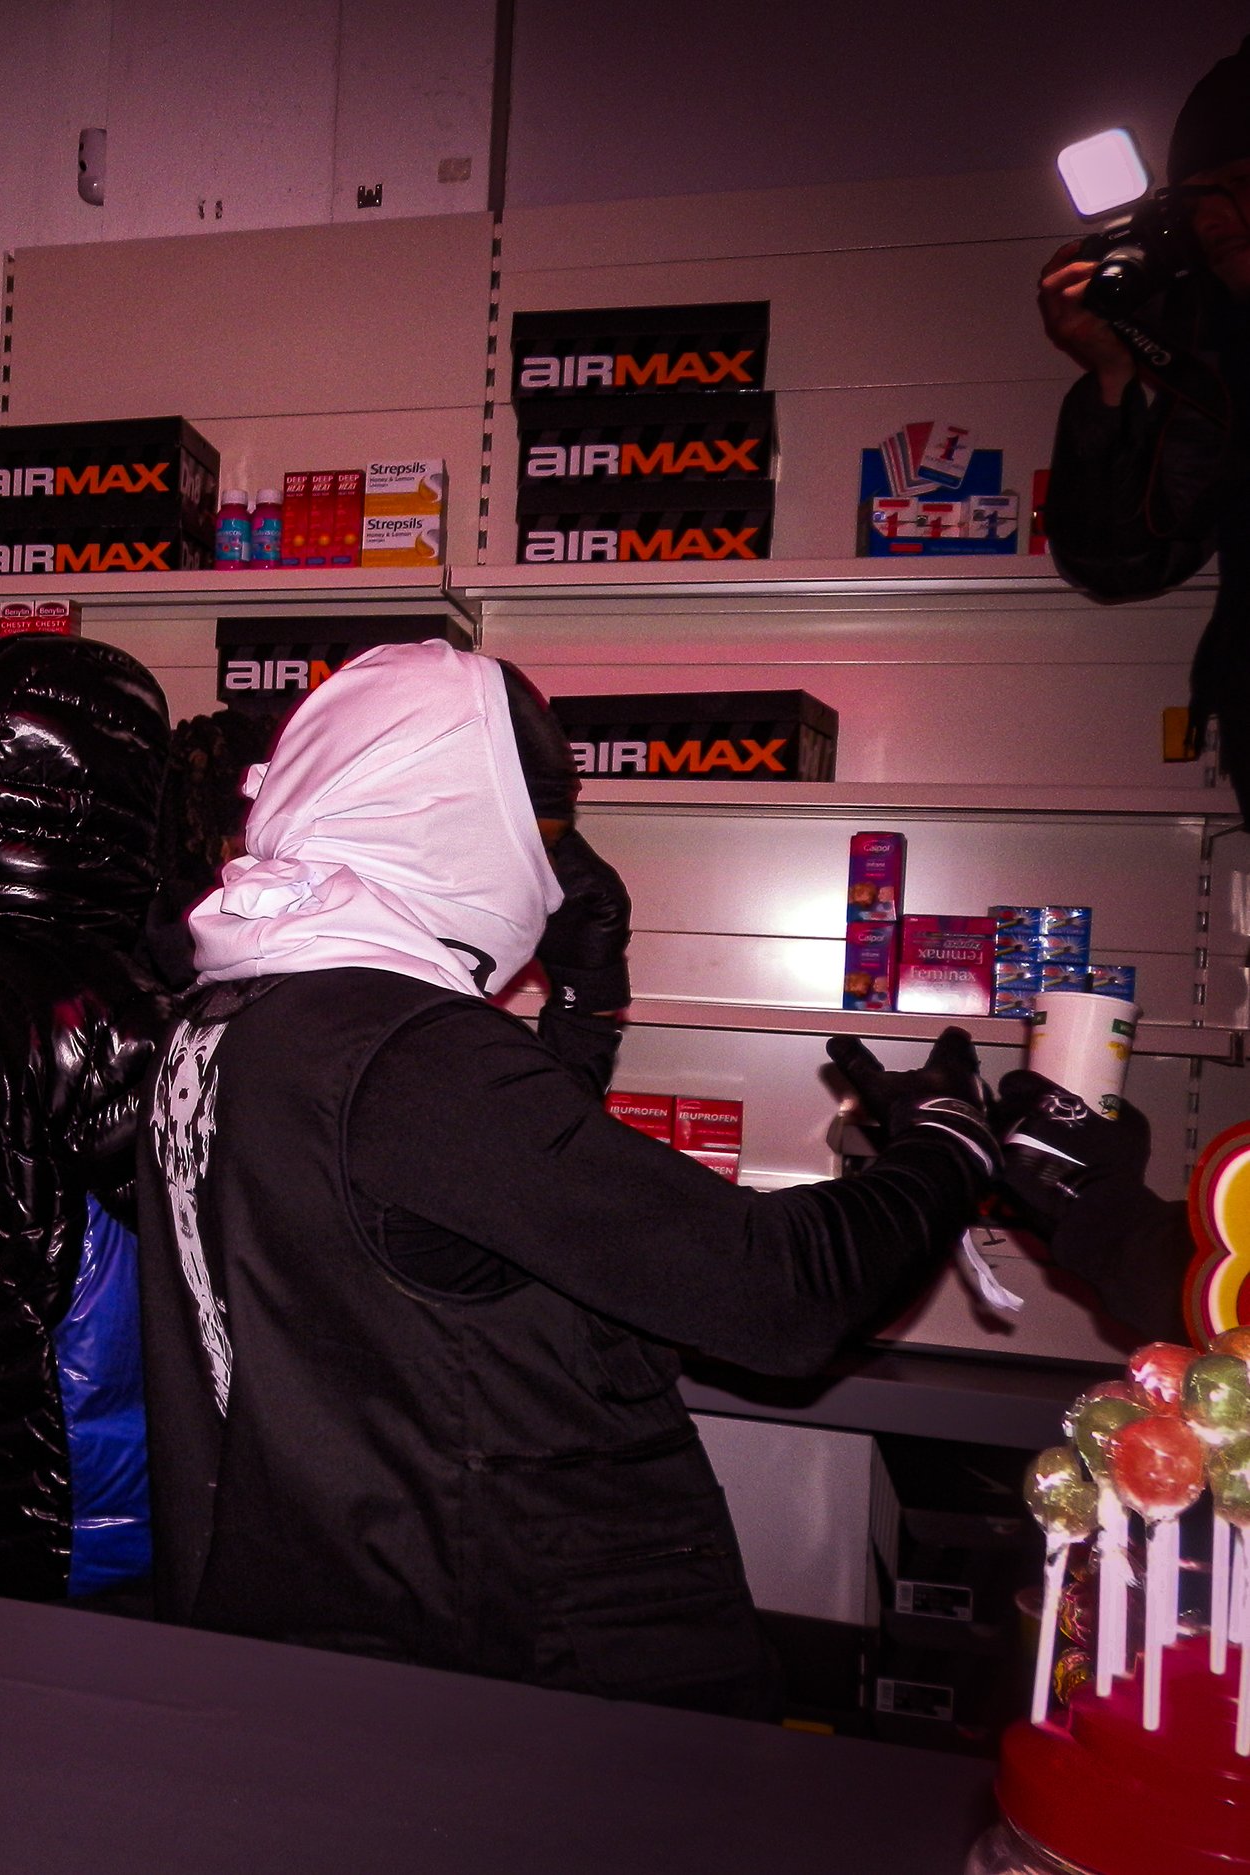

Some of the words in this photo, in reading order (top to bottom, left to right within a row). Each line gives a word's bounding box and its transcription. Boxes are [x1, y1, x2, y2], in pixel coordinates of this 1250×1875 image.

[370, 462, 426, 477] Strepsils
[286, 476, 307, 484] DEEP
[312, 474, 333, 483] DEEP
[338, 473, 360, 482] DEEP
[367, 517, 424, 532] Strepsils
[4, 608, 30, 617] Benylin
[39, 607, 66, 616] Benylin
[1, 621, 31, 629] CHESTY
[35, 620, 67, 628] CHESTY
[918, 948, 984, 965] Feminax
[910, 965, 977, 982] Feminax
[609, 1105, 668, 1117] IBUPROFEN
[679, 1111, 739, 1123] IBUPROFEN
